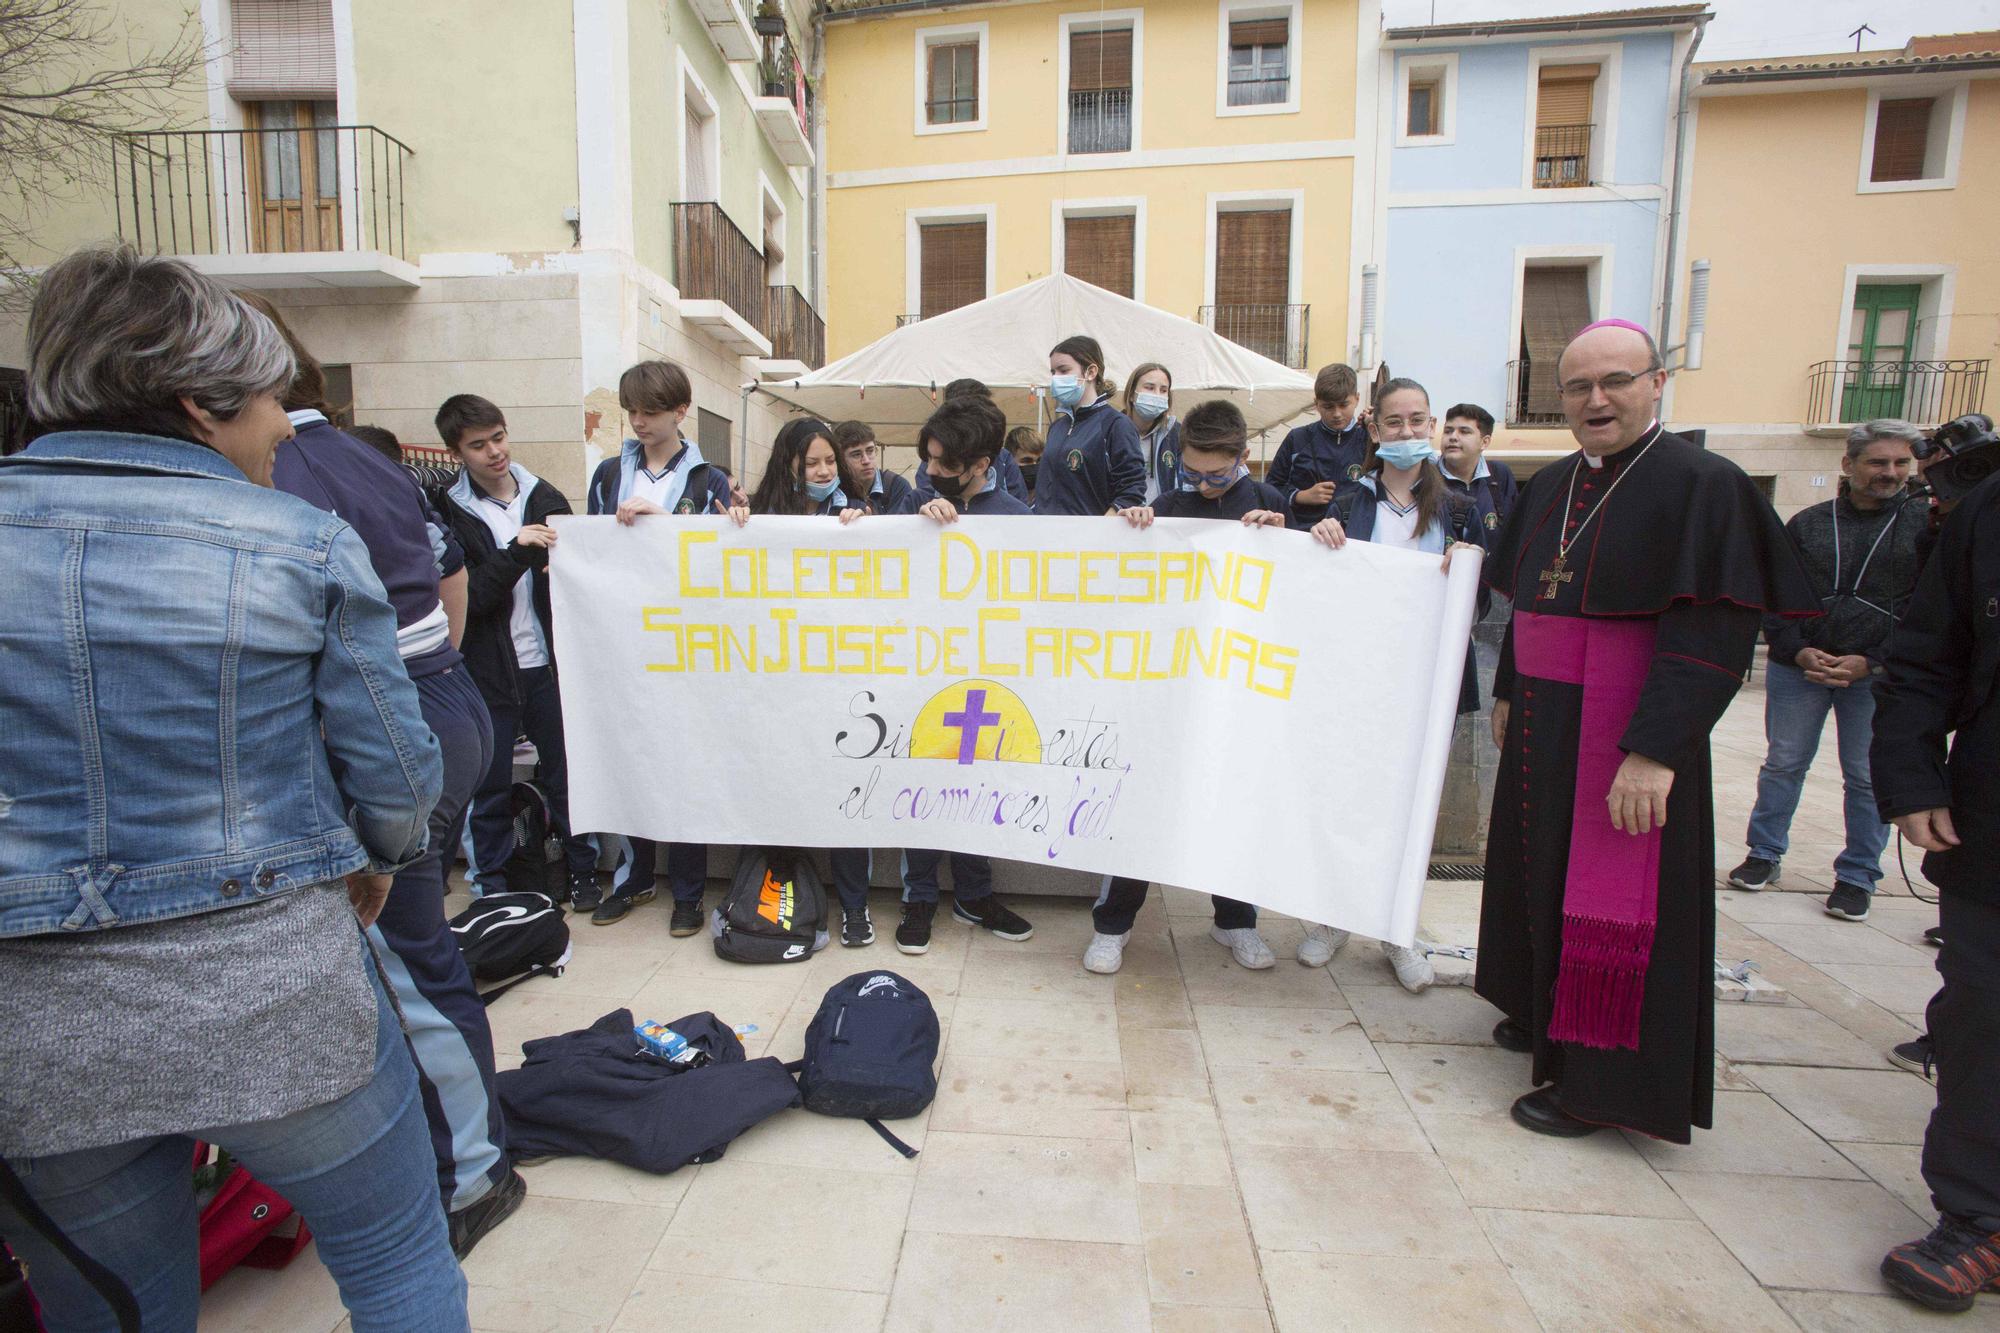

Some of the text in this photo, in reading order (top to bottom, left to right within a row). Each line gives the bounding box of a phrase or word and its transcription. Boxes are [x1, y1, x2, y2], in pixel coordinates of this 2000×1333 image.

[679, 531, 1275, 612] COLEGIO DIOCESANO
[642, 606, 1300, 701] SAN JOSÉ DE CAROLINAS
[835, 690, 916, 759] Si
[839, 764, 874, 820] el
[892, 783, 1028, 826] camino
[1015, 795, 1050, 836] es
